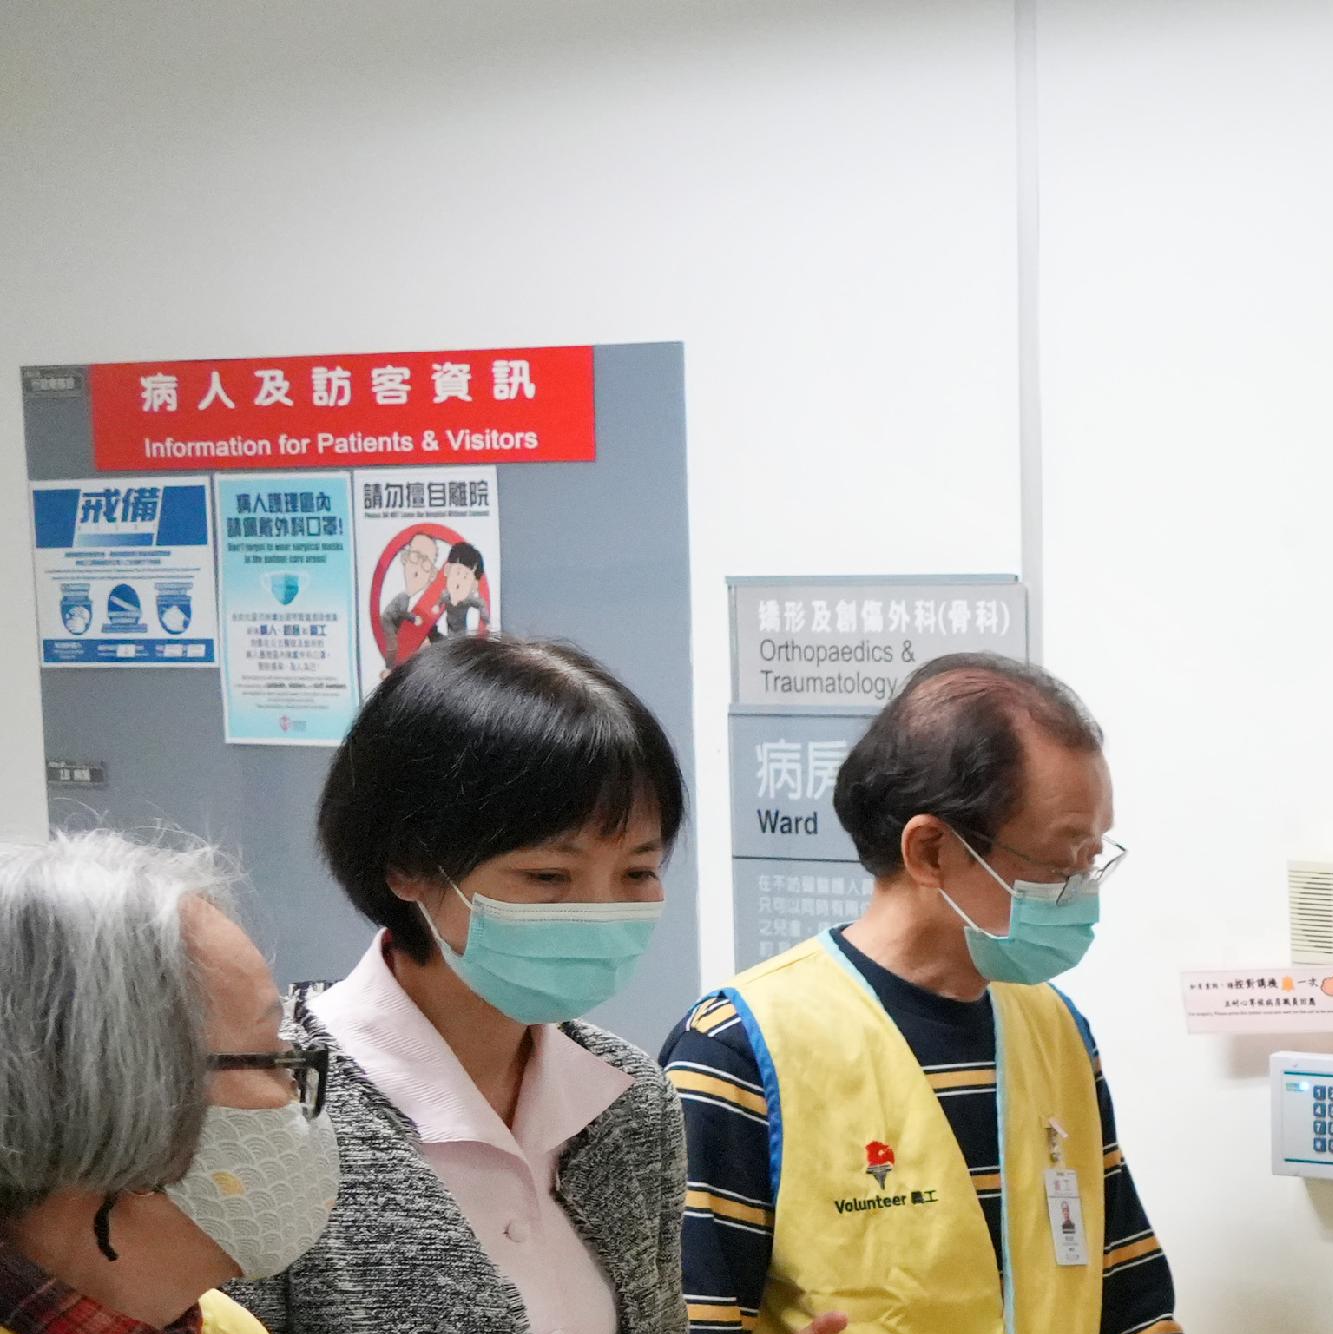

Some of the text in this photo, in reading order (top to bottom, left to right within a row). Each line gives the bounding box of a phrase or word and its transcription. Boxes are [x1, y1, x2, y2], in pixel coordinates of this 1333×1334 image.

[141, 359, 536, 413] 病人及訪客資訊
[144, 428, 539, 460] Information for Patients & Visitors
[81, 487, 162, 523] 戒備
[364, 481, 489, 509] 請勿擅自離院
[758, 599, 1011, 636] 矯形及創傷外科(骨科)
[759, 638, 916, 667] Orthopaedics &
[759, 669, 898, 701] Traumatology
[755, 739, 848, 801] 病房
[757, 809, 818, 834] Ward
[834, 1194, 906, 1214] Volunteer
